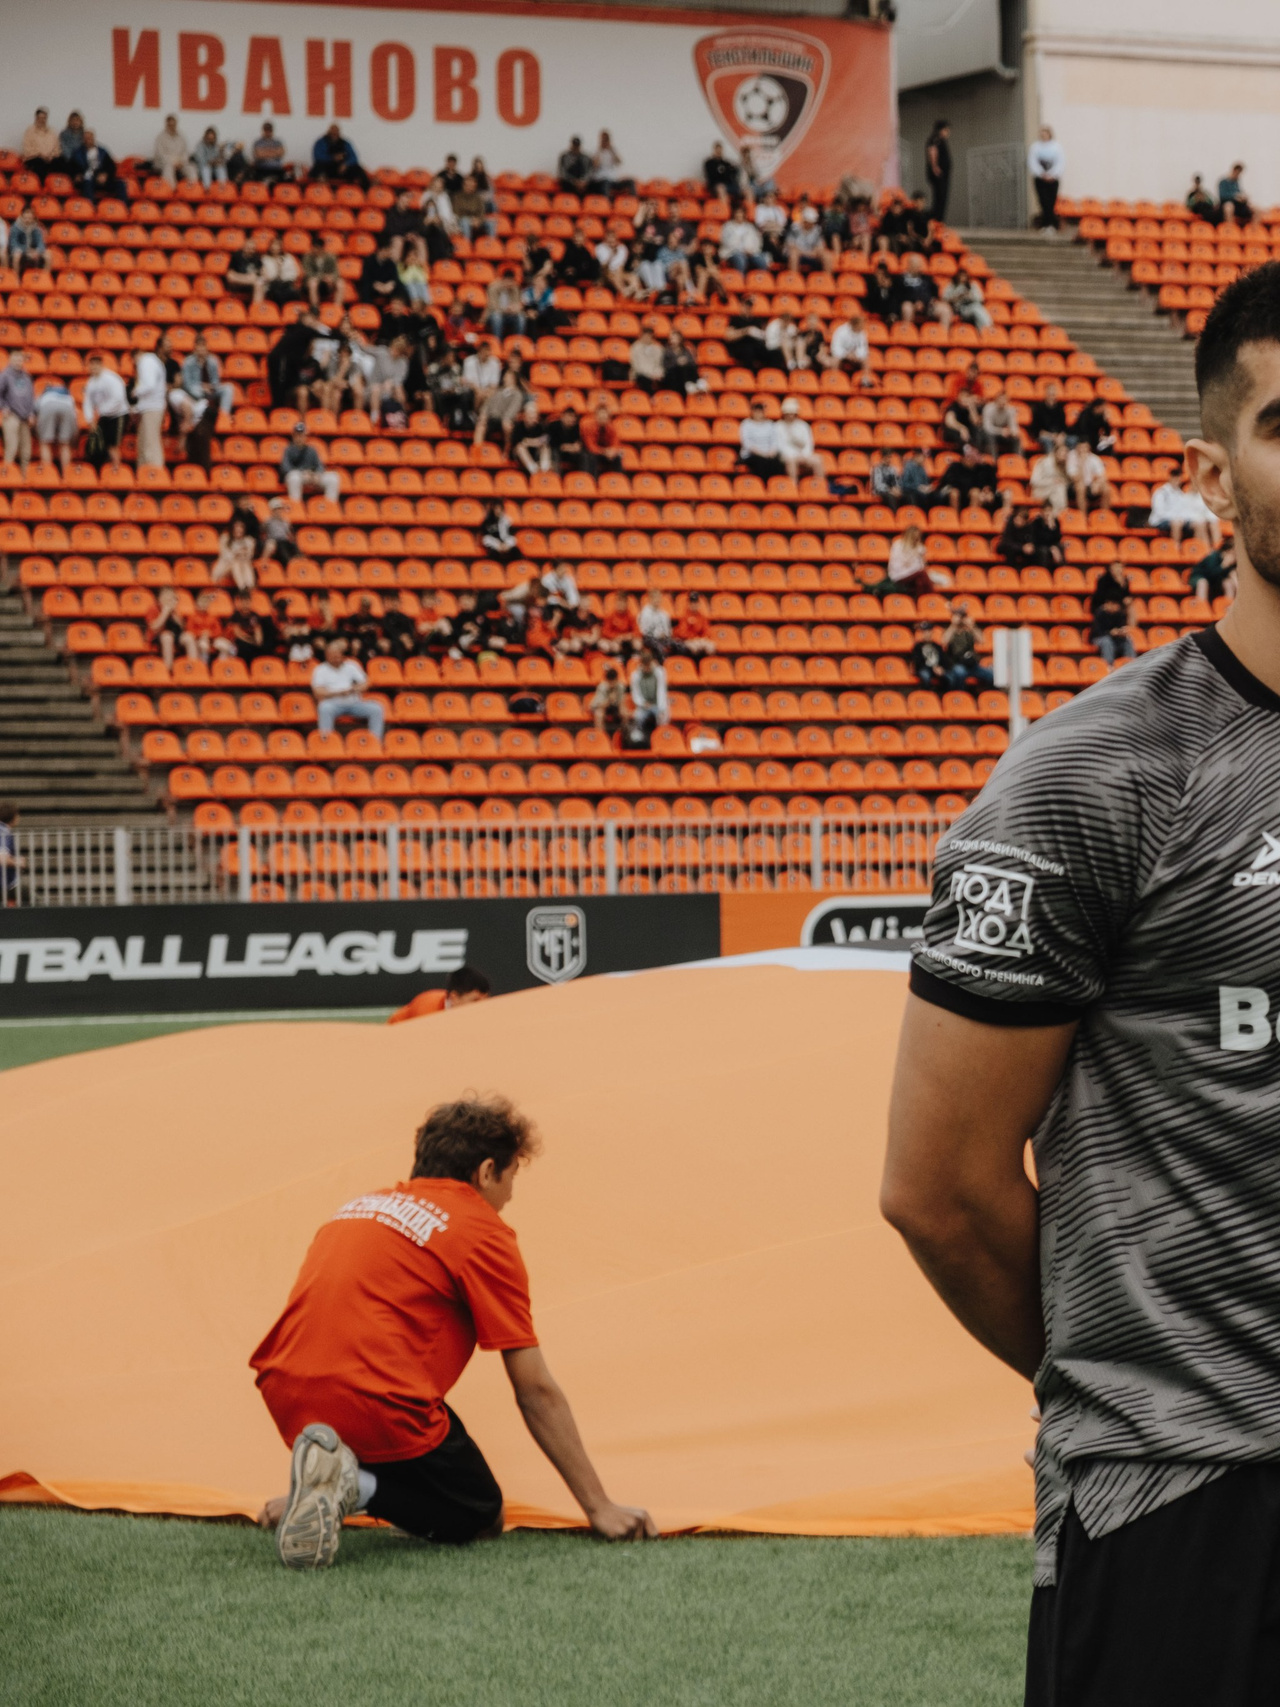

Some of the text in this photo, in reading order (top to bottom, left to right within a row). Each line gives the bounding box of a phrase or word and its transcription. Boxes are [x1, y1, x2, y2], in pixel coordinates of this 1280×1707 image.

[112, 27, 542, 127] ИВАНОВО
[950, 871, 1014, 917] ПОД
[206, 929, 469, 978] LEAGUE
[962, 908, 1035, 955] ХОД
[984, 969, 1045, 986] ТРЕНИНГА
